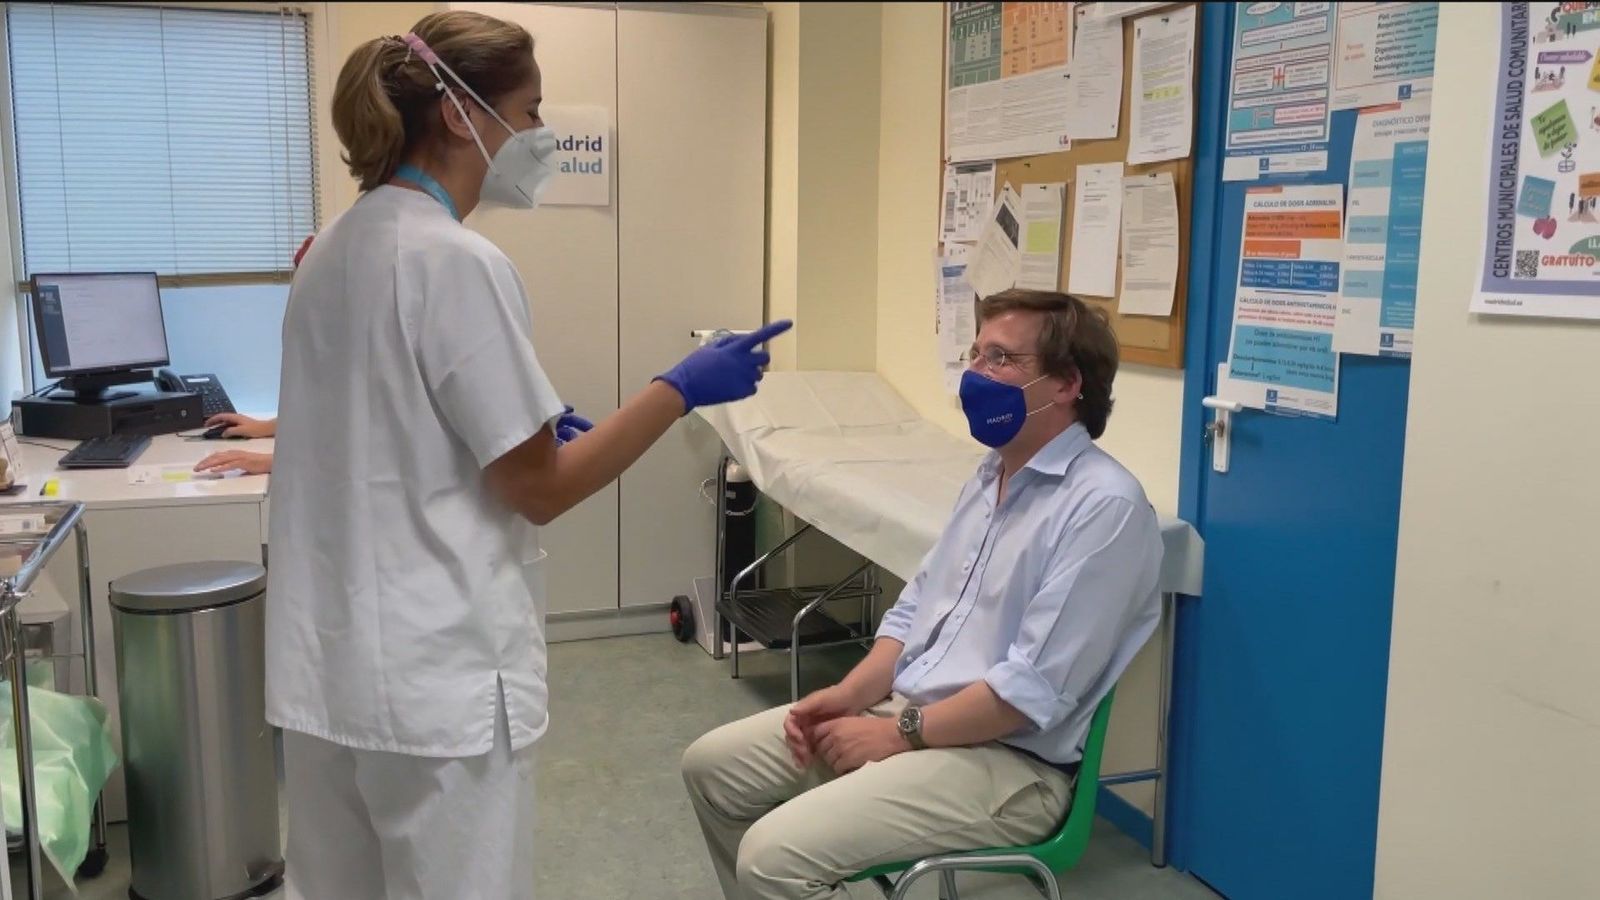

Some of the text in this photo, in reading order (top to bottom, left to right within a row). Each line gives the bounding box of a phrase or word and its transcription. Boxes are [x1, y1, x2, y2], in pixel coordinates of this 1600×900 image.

[1505, 80, 1523, 121] SALUD
[1503, 123, 1520, 140] DE
[559, 157, 602, 174] alud
[1497, 142, 1518, 220] MUNICIPALES
[1493, 223, 1513, 278] CENTROS
[1541, 254, 1595, 267] GRATUÍTO
[987, 412, 1013, 424] MADRID
